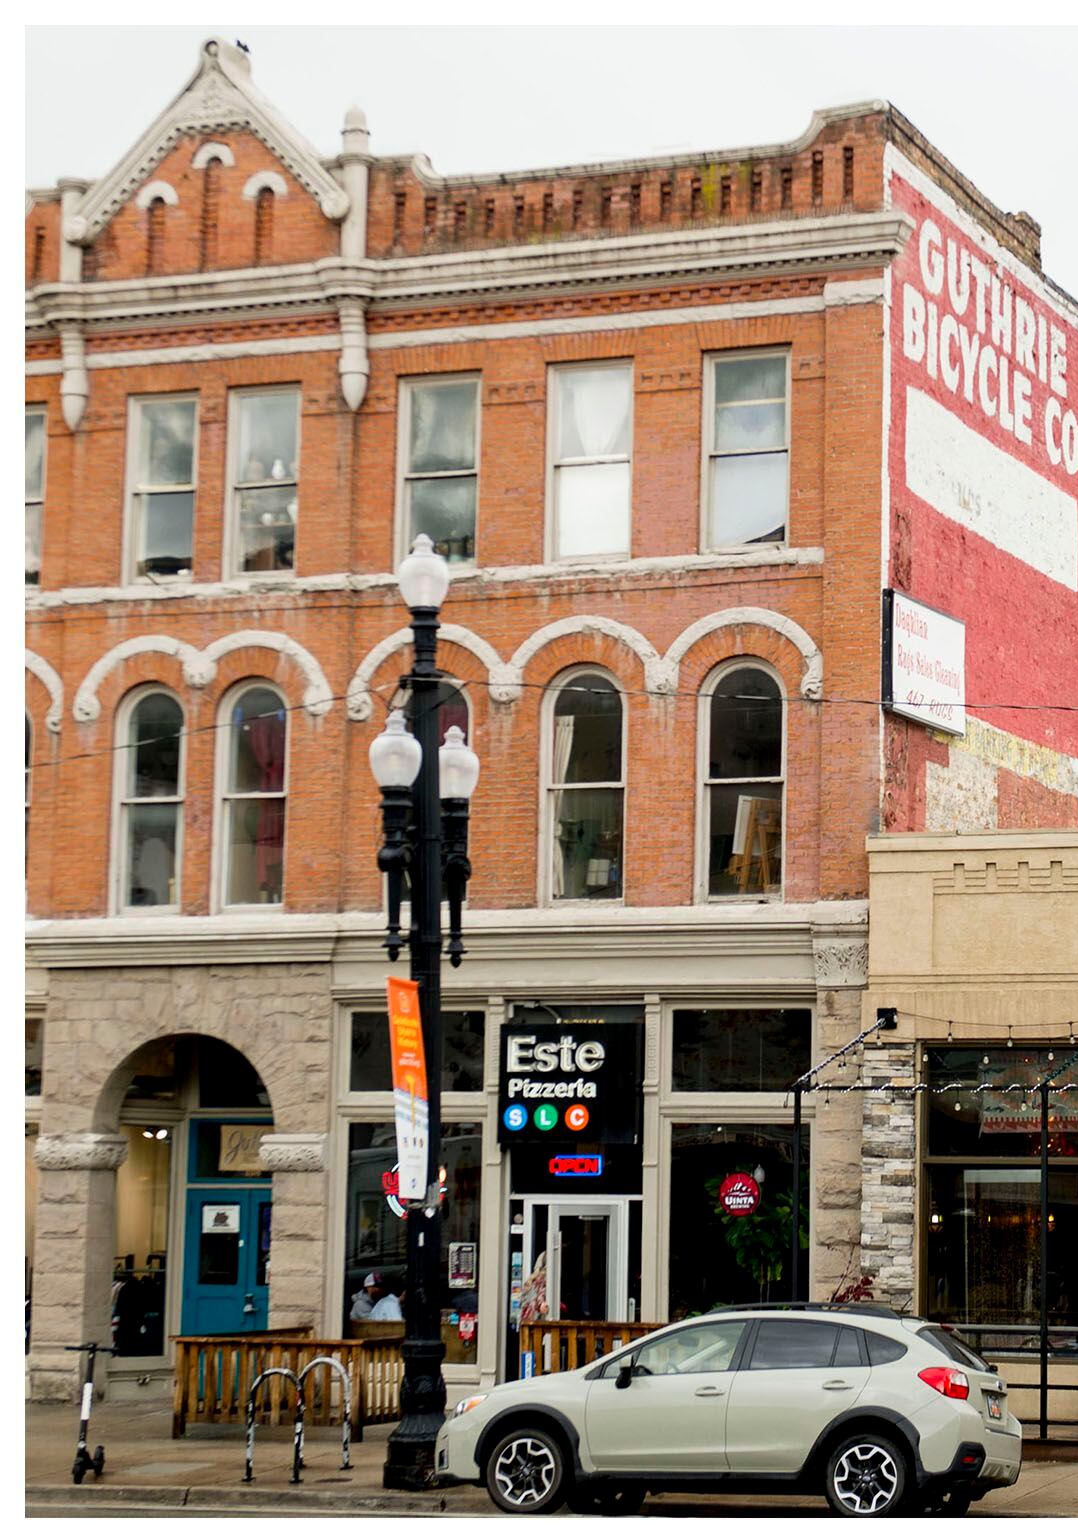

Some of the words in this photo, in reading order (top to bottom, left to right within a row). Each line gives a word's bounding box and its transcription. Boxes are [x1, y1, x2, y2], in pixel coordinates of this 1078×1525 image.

[919, 219, 1068, 398] GUTHRIE
[903, 282, 1033, 446] BICYCLE
[506, 1035, 606, 1073] Este
[508, 1078, 597, 1099] Pizzeria
[549, 1157, 599, 1175] OPEN
[725, 1196, 754, 1206] UINTA
